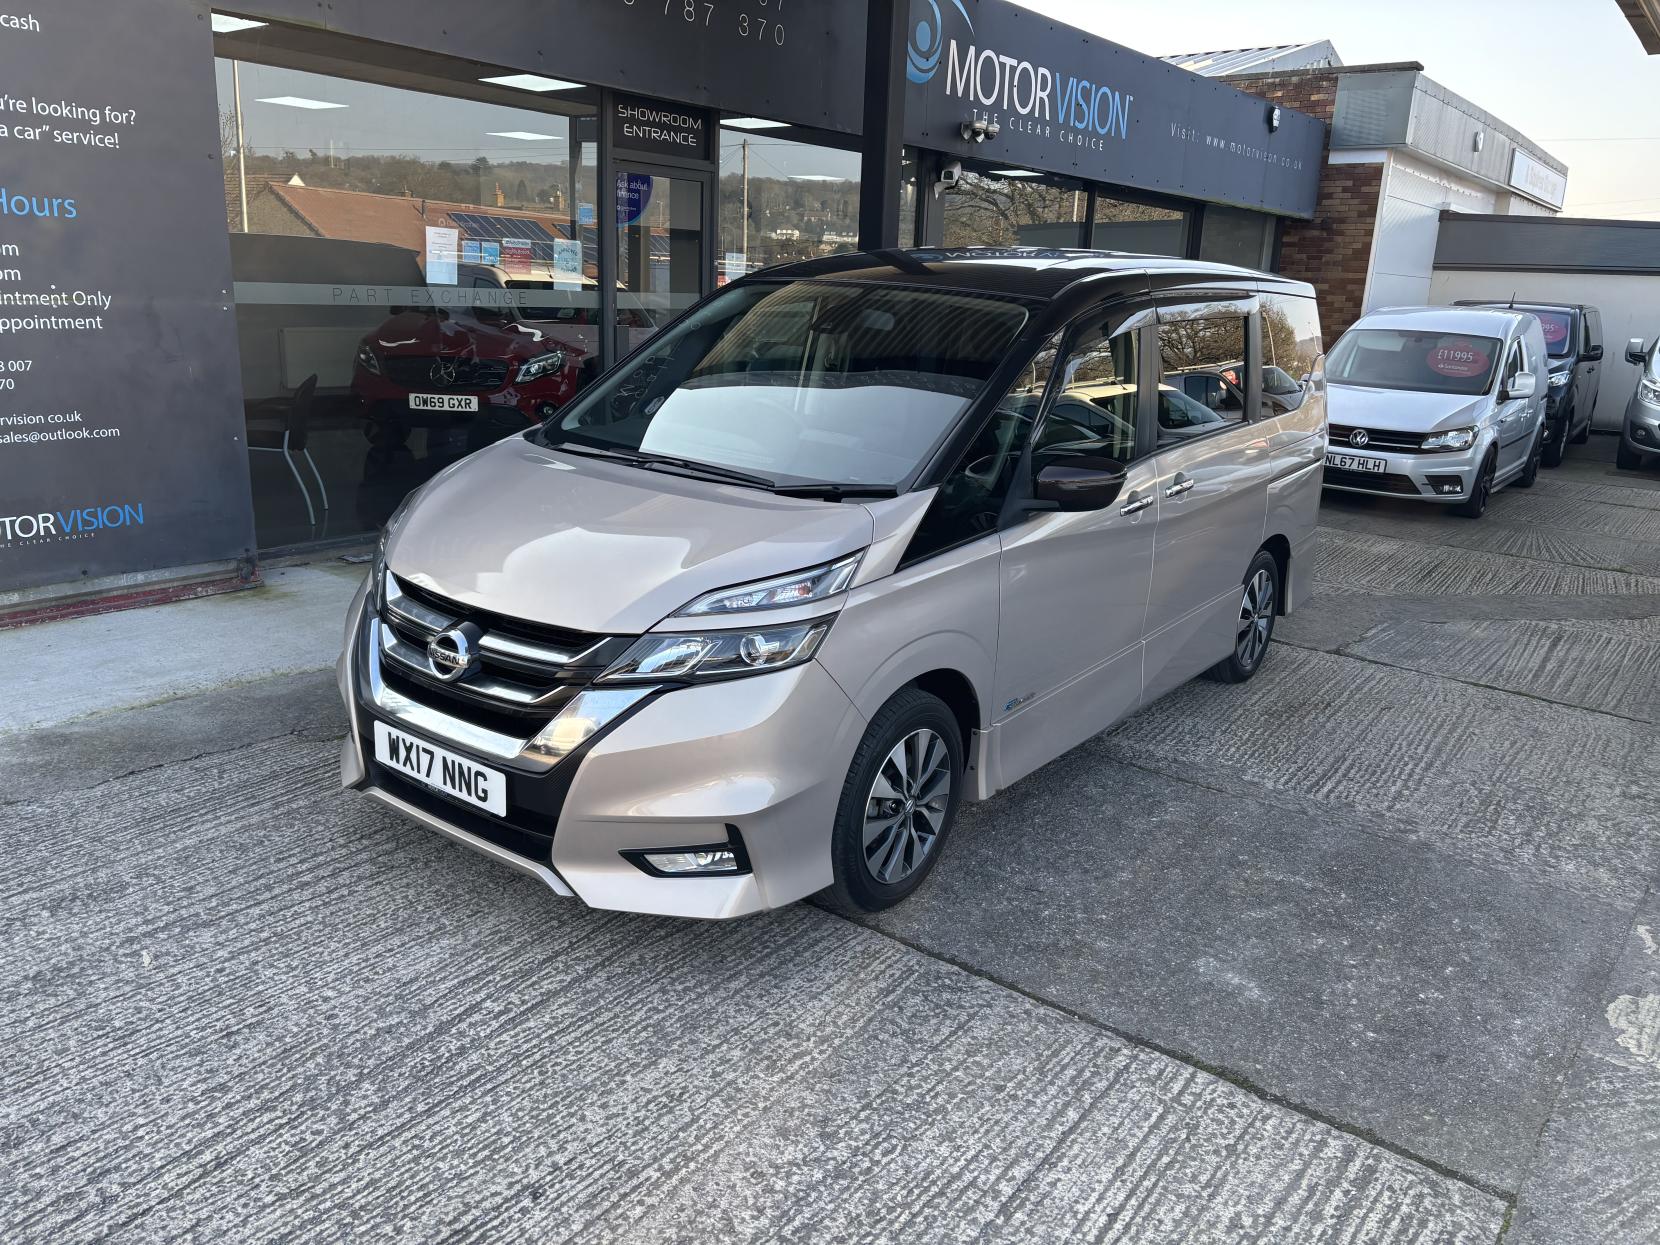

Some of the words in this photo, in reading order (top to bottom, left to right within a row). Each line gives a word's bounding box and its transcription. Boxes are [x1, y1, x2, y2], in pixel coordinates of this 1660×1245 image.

[0, 14, 40, 32] cash
[738, 14, 785, 46] 370
[32, 96, 100, 125] looking
[104, 106, 136, 125] for?
[618, 104, 702, 130] SHOWROOM
[53, 130, 120, 149] service!
[623, 123, 697, 146] ENTRANCE
[973, 109, 998, 125] THE
[1010, 117, 1050, 138] CLEAR
[1060, 130, 1104, 151] CHOICE
[1170, 122, 1200, 143] Visit:
[616, 179, 629, 188] Ask
[630, 180, 649, 190] about
[72, 290, 112, 310] Only
[332, 287, 393, 303] PART
[410, 289, 528, 305] EXCHANGE
[1437, 349, 1474, 362] £11995
[8, 360, 32, 372] 007
[414, 395, 445, 409] OW69
[447, 396, 472, 410] GXR
[1324, 454, 1355, 467] NL67
[1357, 458, 1381, 472] HLH
[20, 538, 51, 546] CLEAR
[59, 532, 95, 541] CHOICE
[431, 646, 460, 665] NISSAN
[387, 731, 435, 779] WX17
[442, 755, 489, 803] NNG
